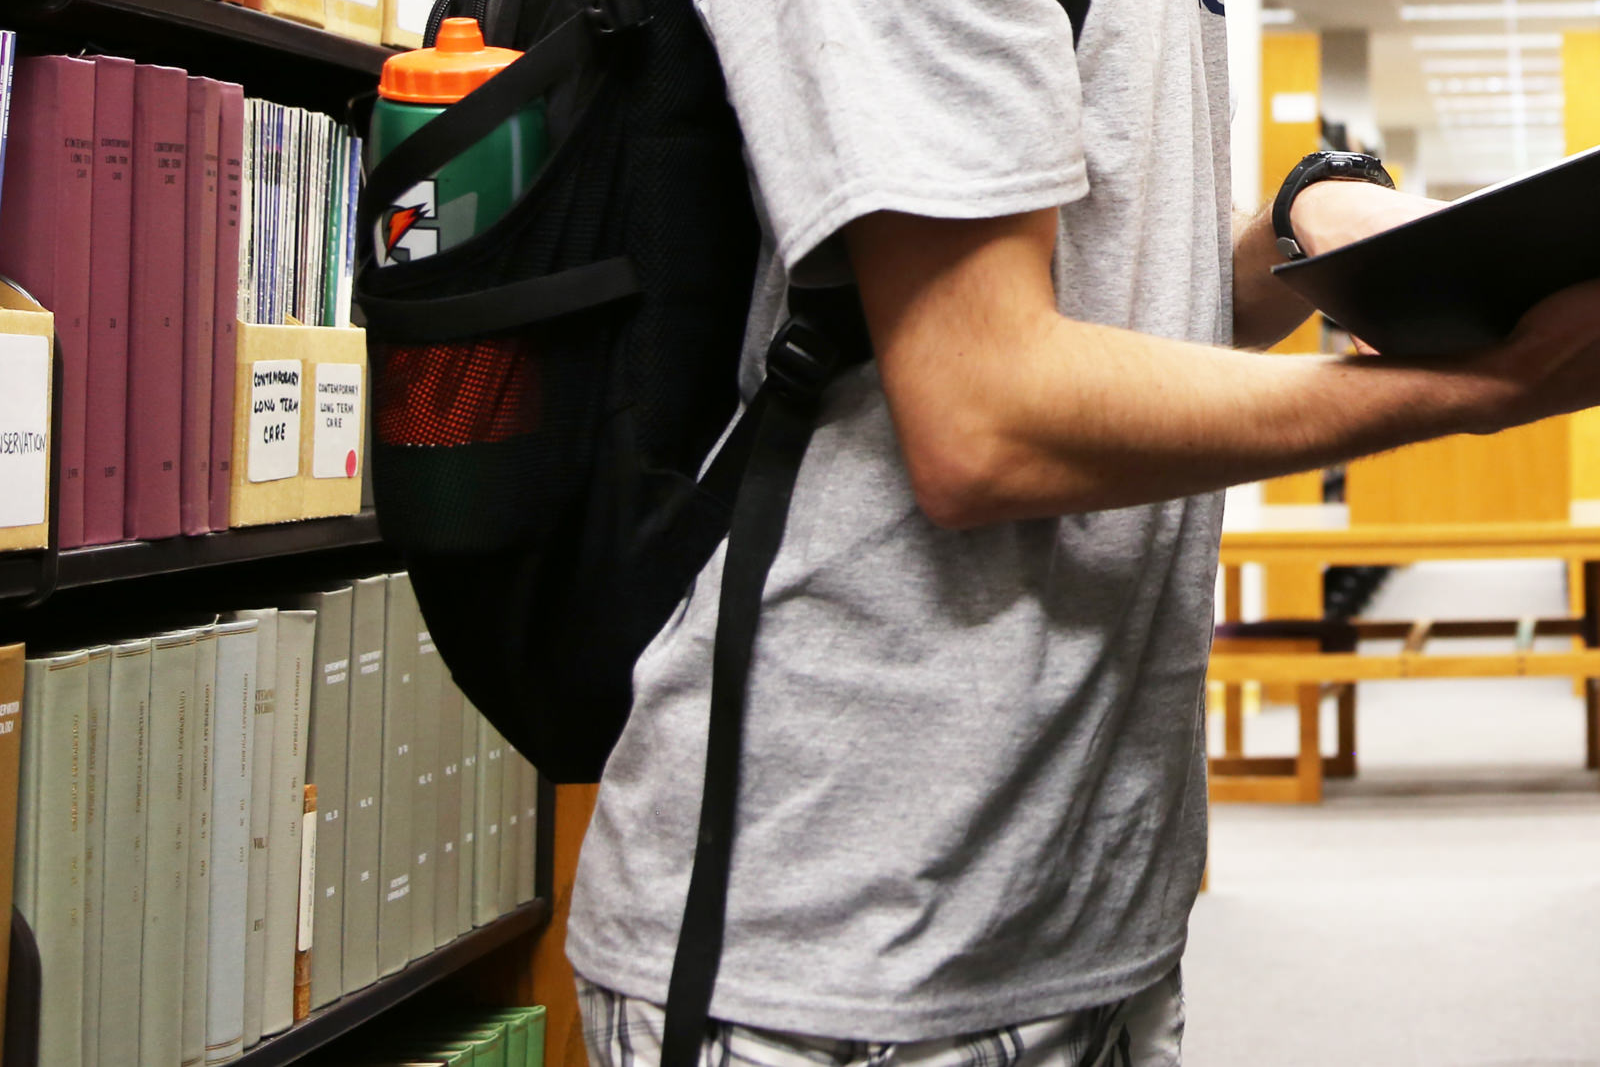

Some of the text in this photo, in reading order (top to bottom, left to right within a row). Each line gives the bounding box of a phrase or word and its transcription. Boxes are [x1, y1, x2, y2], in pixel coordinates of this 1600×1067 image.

[254, 370, 299, 387] CONTEMPORARY
[318, 383, 358, 396] CONTEMPORARY
[254, 398, 298, 414] LONG TERM
[320, 403, 354, 414] LONG TERM
[326, 418, 342, 428] CARE
[264, 422, 286, 443] CARE
